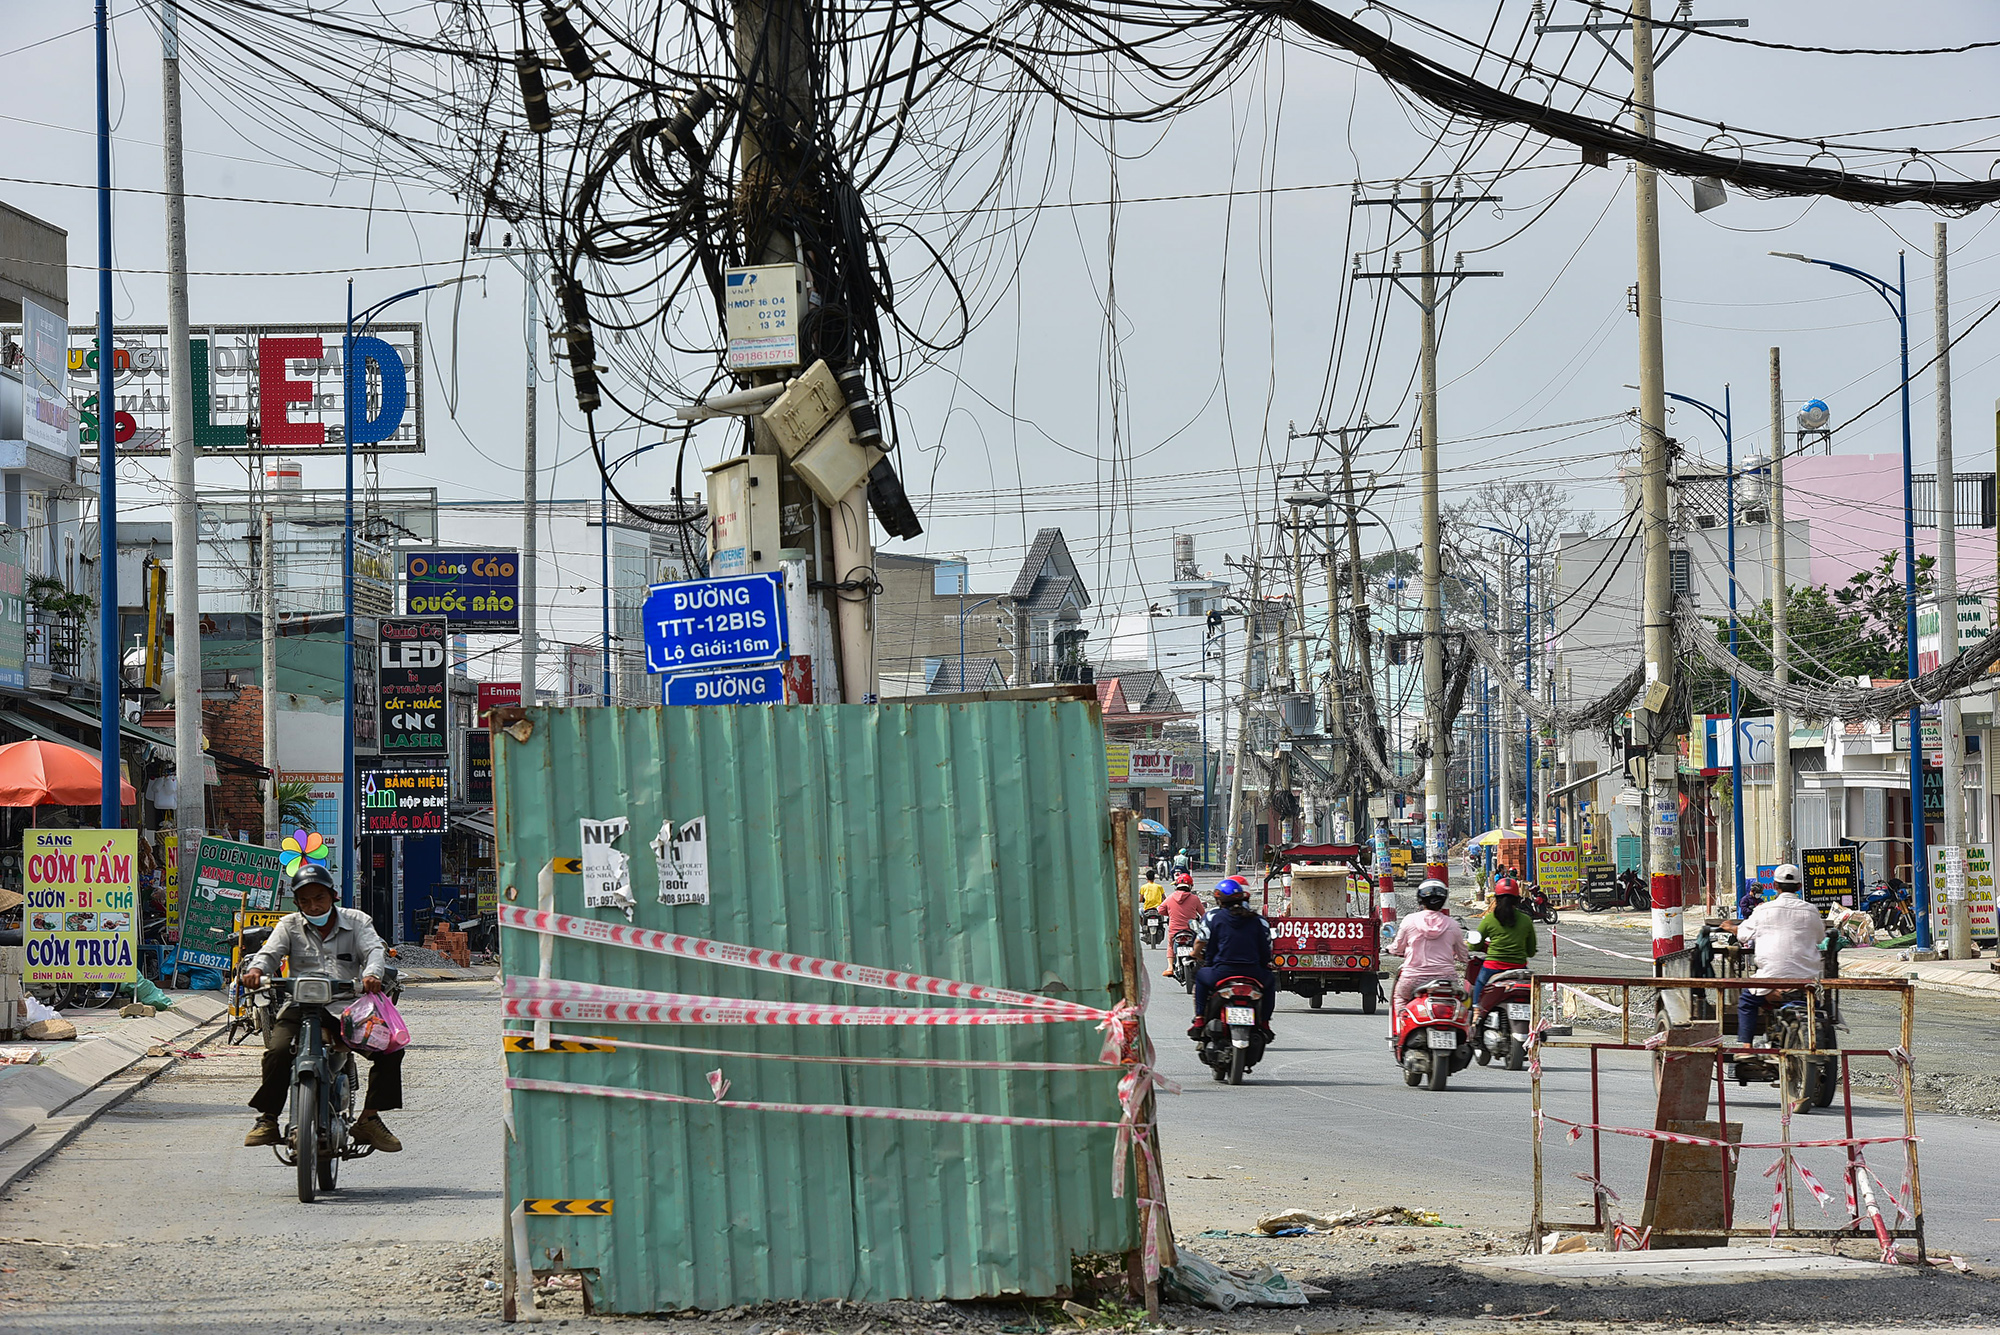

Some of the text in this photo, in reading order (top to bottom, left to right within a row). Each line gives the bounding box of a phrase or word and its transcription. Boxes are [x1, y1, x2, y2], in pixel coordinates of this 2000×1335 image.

[728, 300, 755, 308] HMOF
[775, 320, 785, 328] 24
[732, 349, 794, 361] 0918615715
[189, 336, 406, 446] LED
[472, 557, 514, 577] Cáo
[411, 588, 514, 613] QUỐC BẢO
[674, 584, 750, 611] ĐƯỜNG
[657, 610, 767, 638] TTT-12BIS
[382, 641, 444, 668] LED
[664, 645, 685, 663] Lộ
[397, 685, 427, 695] THUẬT
[429, 683, 443, 693] SỐ
[695, 674, 766, 700] ĐƯỜNG
[385, 697, 405, 709] CẮT
[413, 695, 441, 709] KHẮC
[392, 712, 436, 731] CNC
[384, 734, 443, 747] LASER
[1133, 751, 1161, 767] THÚ
[1163, 755, 1172, 767] Y
[286, 773, 336, 782] TOÀN LÀ TRÊN
[385, 775, 444, 790] BẢNG HIỆU
[325, 790, 335, 798] CÁO
[399, 795, 444, 808] HỘP ĐÈN
[370, 811, 440, 829] KHẮC DẤU
[37, 833, 72, 845] SÁNG
[584, 824, 629, 845] NH
[28, 848, 77, 883] CƠM
[81, 840, 132, 883] TẤM
[201, 845, 280, 871] CƠ ĐIỆN LẠNH
[1539, 849, 1575, 863] CƠM
[1807, 855, 1826, 863] MUA
[1833, 852, 1851, 862] BÁN
[1809, 864, 1851, 875] SỬA CHỮA
[200, 865, 273, 889] MINH CHÂU
[1813, 876, 1847, 887] ÉP KÍNH
[27, 888, 65, 908] SƯỜN
[78, 888, 92, 908] BÌ
[105, 886, 133, 909] CHẢ
[587, 897, 599, 906] ĐT:
[677, 893, 690, 902] 913
[1981, 891, 1993, 901] DA
[1976, 905, 1994, 914] MỤN
[26, 933, 132, 966] CƠM TRƯA
[182, 951, 231, 969] ĐT: 0937.7
[33, 970, 73, 980] BÌNH DÂN
